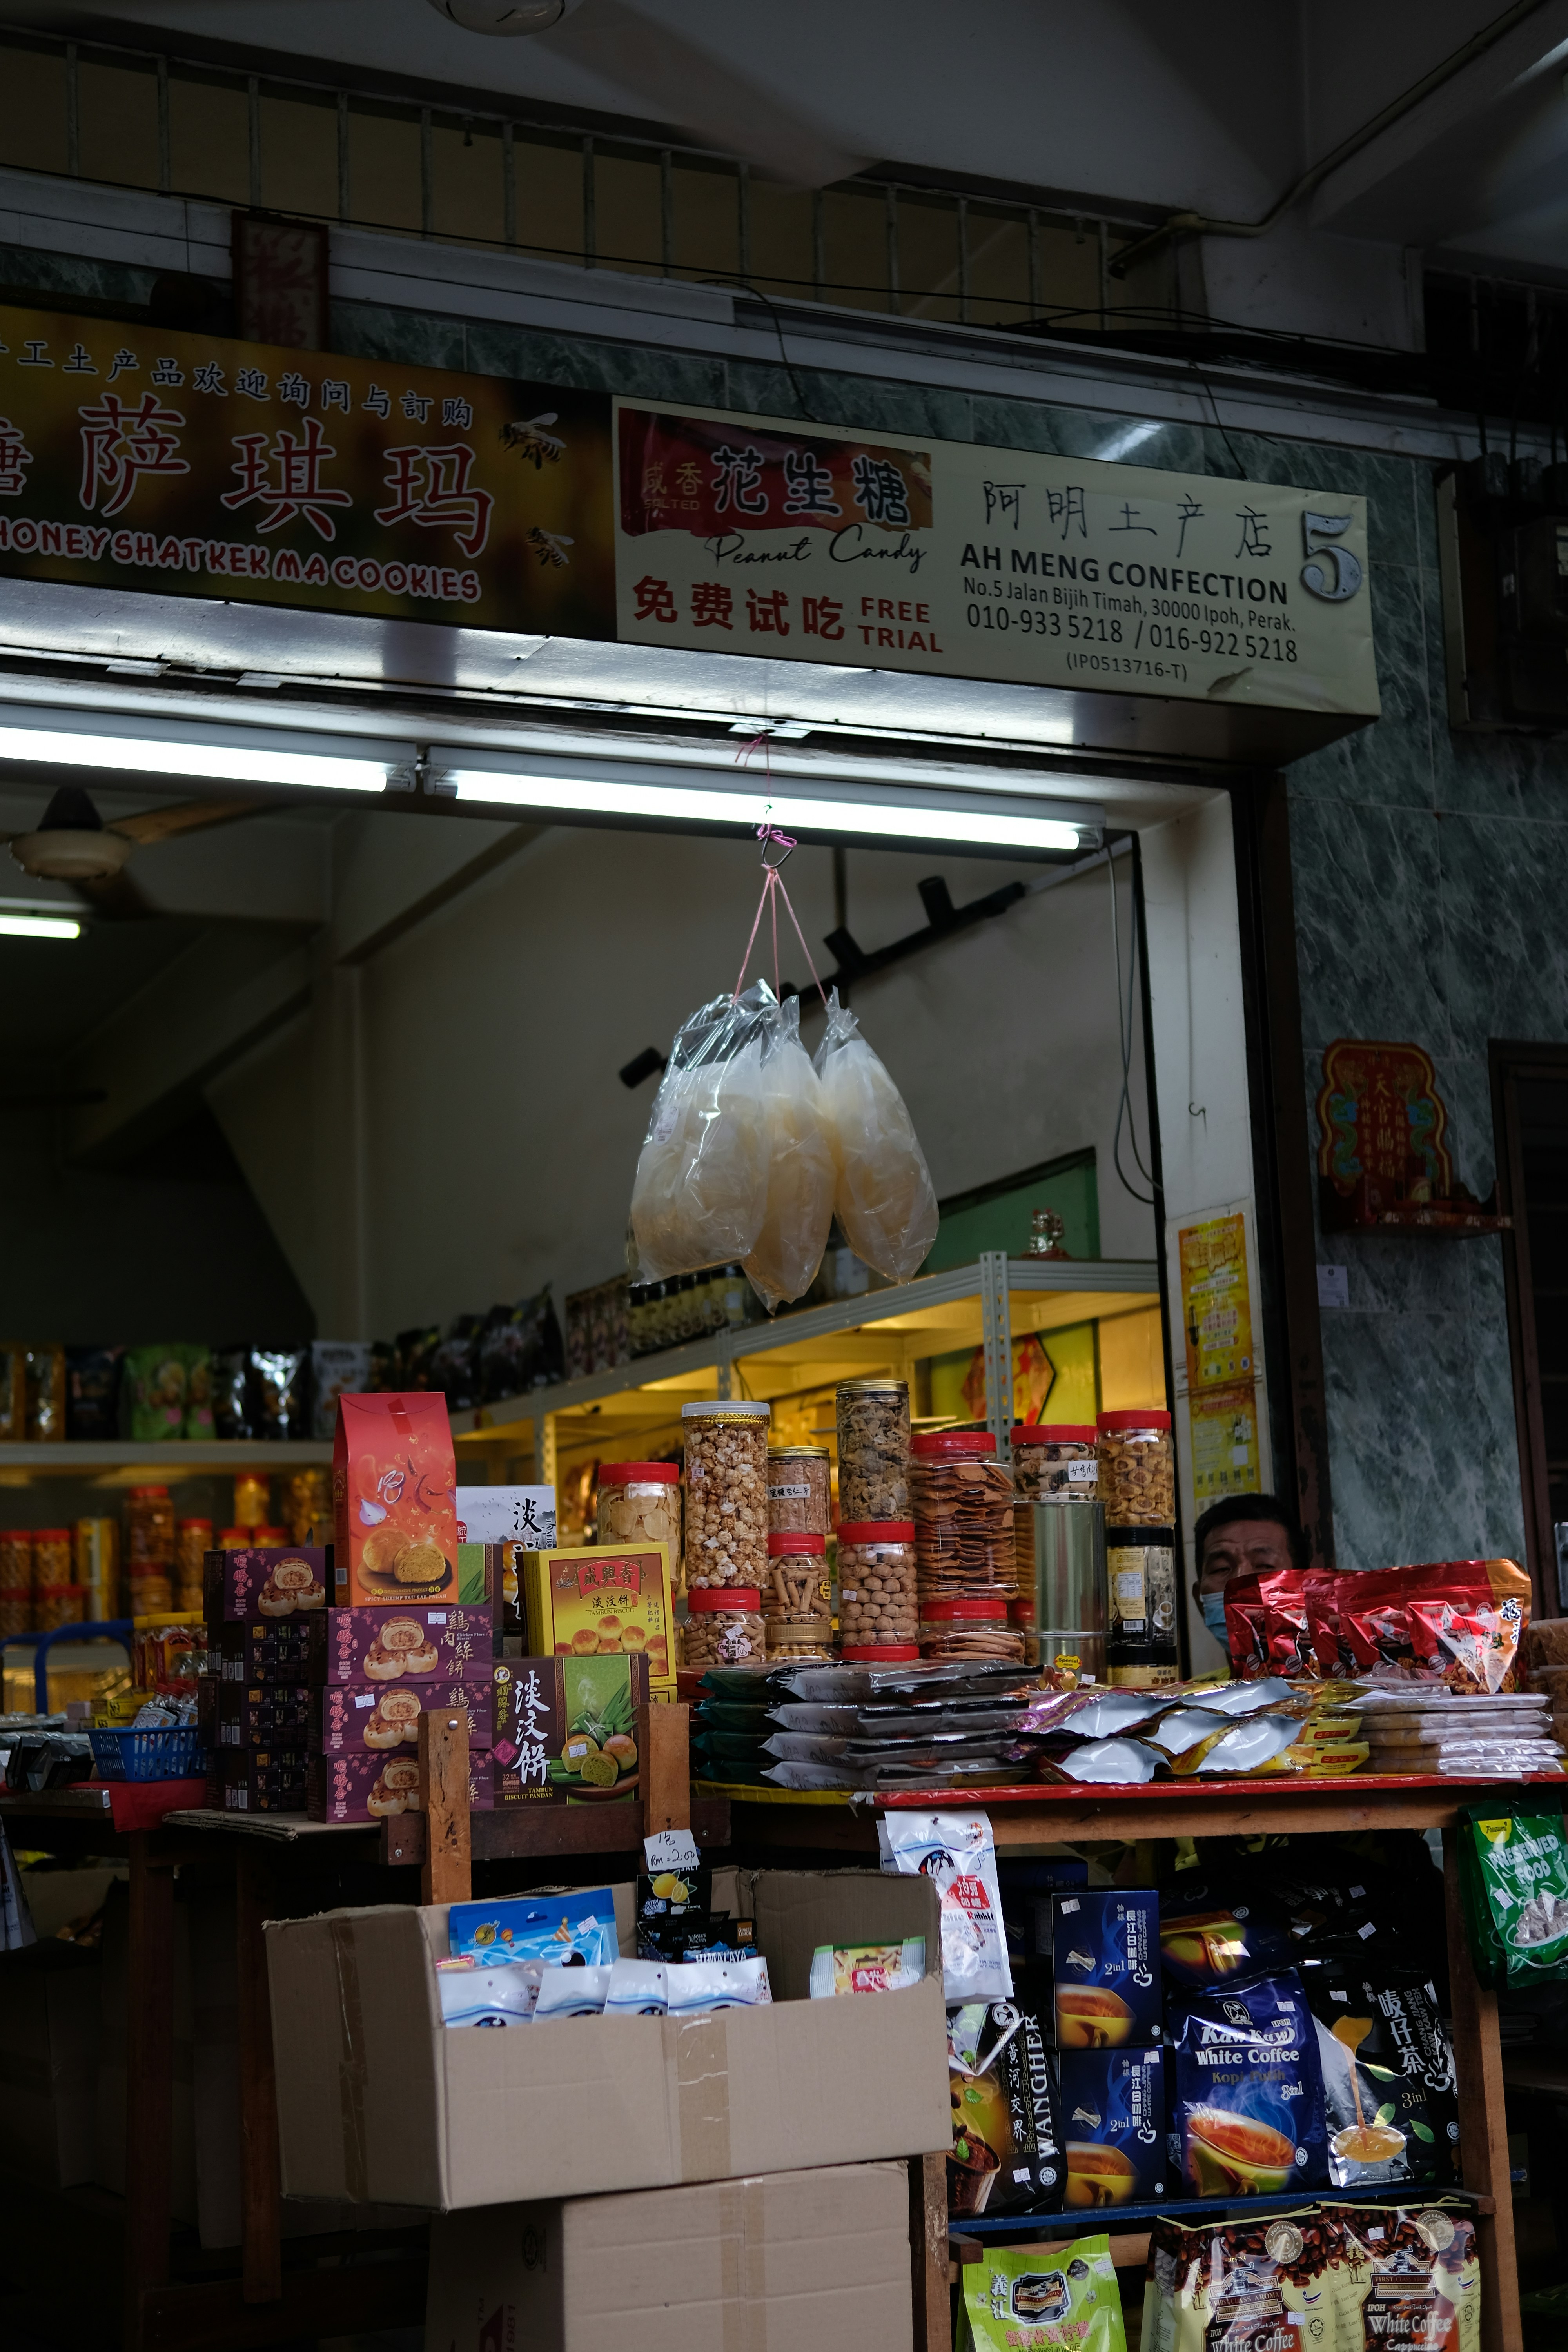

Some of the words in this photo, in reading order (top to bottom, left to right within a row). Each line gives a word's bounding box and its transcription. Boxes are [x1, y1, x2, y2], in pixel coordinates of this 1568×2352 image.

[0, 339, 473, 430] 工土产品欢迎询问与訂购
[711, 445, 910, 527] 花生糖
[644, 499, 700, 511] SALTED
[984, 481, 1272, 558] 阿明土产店
[705, 532, 811, 568] Peanut
[829, 524, 927, 574] Candy
[1300, 510, 1363, 601] 5
[274, 549, 330, 586] MA
[331, 556, 482, 603] COOKIES
[961, 544, 1002, 571] AH
[1012, 549, 1099, 581] MENG
[1109, 561, 1288, 604] CONFECTION
[633, 576, 845, 641] 免费试吃
[862, 597, 929, 623] FREE
[964, 577, 1002, 599] No.5
[1007, 582, 1048, 603] Jalan
[1053, 588, 1089, 610] Bijih
[1093, 591, 1147, 617] Timah,
[1152, 598, 1200, 621] 30000
[1205, 605, 1244, 629] Ipoh,
[1249, 611, 1296, 632] Perak.
[858, 625, 943, 653] TRIAL
[967, 604, 1062, 636] 010-933
[1068, 614, 1123, 644] 5218
[1134, 620, 1144, 649] /
[1150, 626, 1240, 657] 016-922
[1245, 635, 1298, 662] 5218
[1488, 1834, 1559, 1869] PRESERVED
[1515, 1859, 1552, 1885] FOOD
[645, 1904, 659, 1913] COOL
[967, 1911, 994, 1921] Rabbit
[1126, 1909, 1138, 1971] 長江白咖啡
[695, 1949, 747, 1964] HIMALAYA
[1105, 1960, 1125, 1975] 2in1
[1404, 1990, 1421, 2018] JIANG
[1411, 1988, 1424, 2006] TEH
[1271, 2018, 1292, 2028] IPOH
[1418, 2007, 1432, 2031] KAW
[1201, 2026, 1246, 2044] Kaw
[1416, 2020, 1432, 2057] CHANG
[1195, 2049, 1243, 2065] White
[1247, 2047, 1300, 2064] Coffee
[1025, 2013, 1060, 2160] WANGHER
[1212, 2071, 1244, 2085] Kopi
[1249, 2069, 1285, 2082] Putih
[1281, 2080, 1304, 2100] 3in1
[1131, 2065, 1142, 2127] 長江白咖啡
[1401, 2088, 1428, 2109] 3in1
[1110, 2116, 1130, 2132] 2in1
[1270, 2225, 1281, 2236] IPOH
[991, 2274, 1009, 2320] 義江
[1230, 2295, 1251, 2305] CLASS
[1254, 2291, 1279, 2301] AROMA
[1349, 2290, 1358, 2299] Sugar
[1367, 2304, 1387, 2312] IPOH
[1210, 2328, 1223, 2337] IPOH
[1367, 2312, 1411, 2334] White
[1412, 2310, 1452, 2341] Coffee
[1210, 2334, 1252, 2352] White
[1254, 2327, 1295, 2352] Coffee
